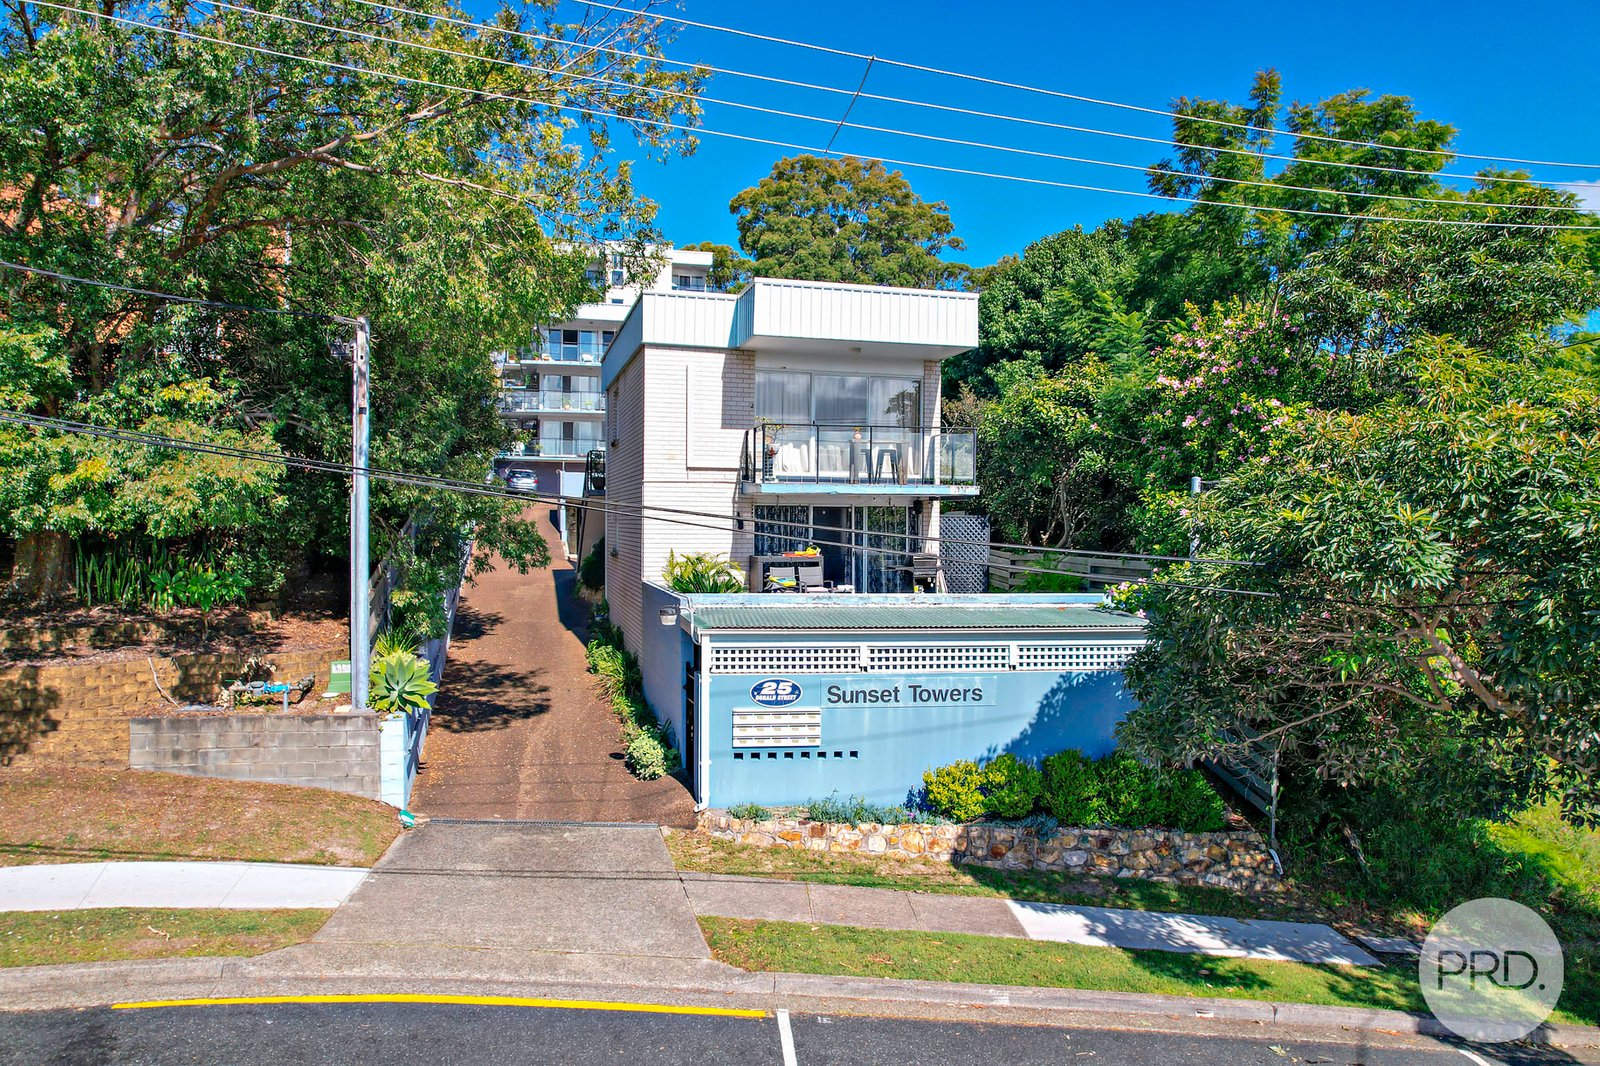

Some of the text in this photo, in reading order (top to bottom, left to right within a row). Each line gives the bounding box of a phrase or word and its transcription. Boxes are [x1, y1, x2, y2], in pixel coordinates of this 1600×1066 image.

[760, 682, 792, 694] 25
[827, 684, 983, 705] Sunset Towers
